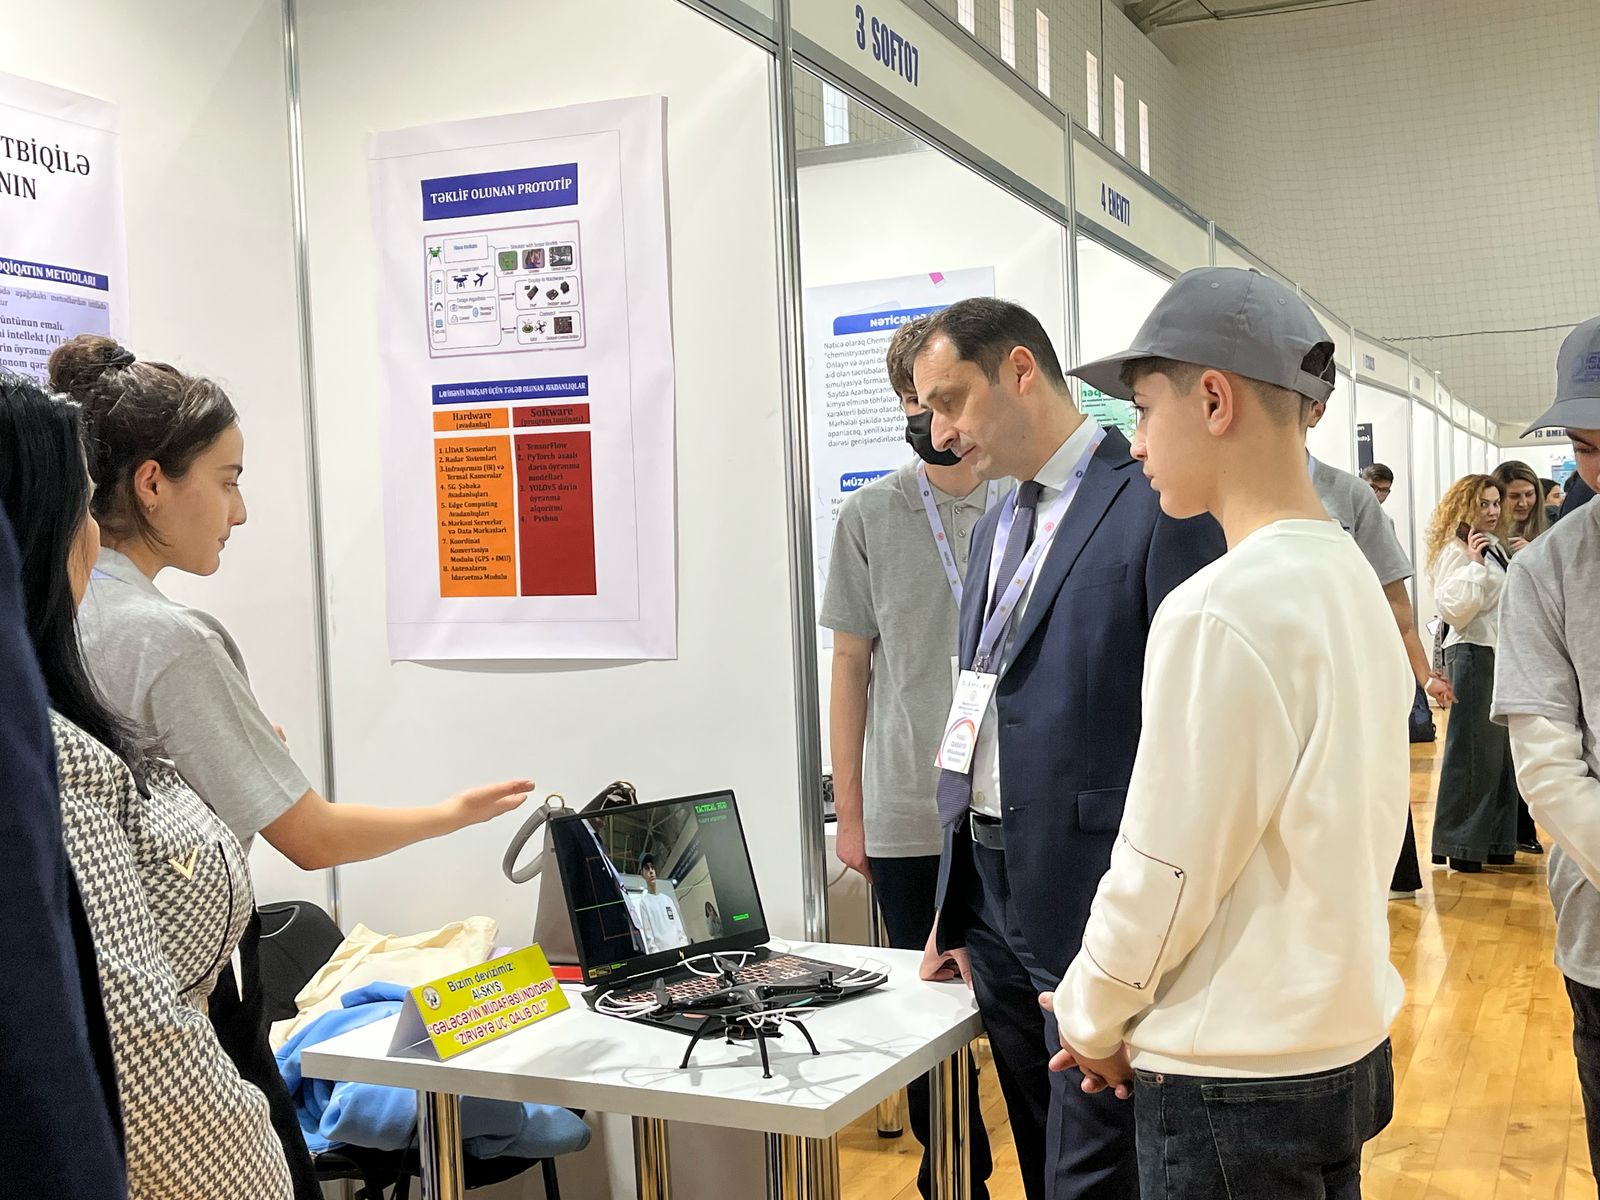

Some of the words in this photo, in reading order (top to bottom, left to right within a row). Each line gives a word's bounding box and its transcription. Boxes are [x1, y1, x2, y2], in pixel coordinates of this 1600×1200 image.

[855, 4, 866, 51] 3
[871, 16, 919, 87] SOFT07
[430, 188, 469, 204] TƏKLİF
[471, 185, 515, 199] OLUNAN
[518, 176, 572, 194] PROTOTİP
[1100, 182, 1106, 211] 4
[45, 268, 96, 287] METODLARI
[7, 330, 47, 343] intellekt
[453, 411, 492, 421] Hardware
[530, 407, 574, 417] Software
[527, 442, 567, 450] TensorFlow
[528, 452, 556, 462] PyTorch
[447, 975, 474, 993] Bizim
[474, 962, 516, 983] devizimiz:
[508, 1006, 533, 1025] QALİB
